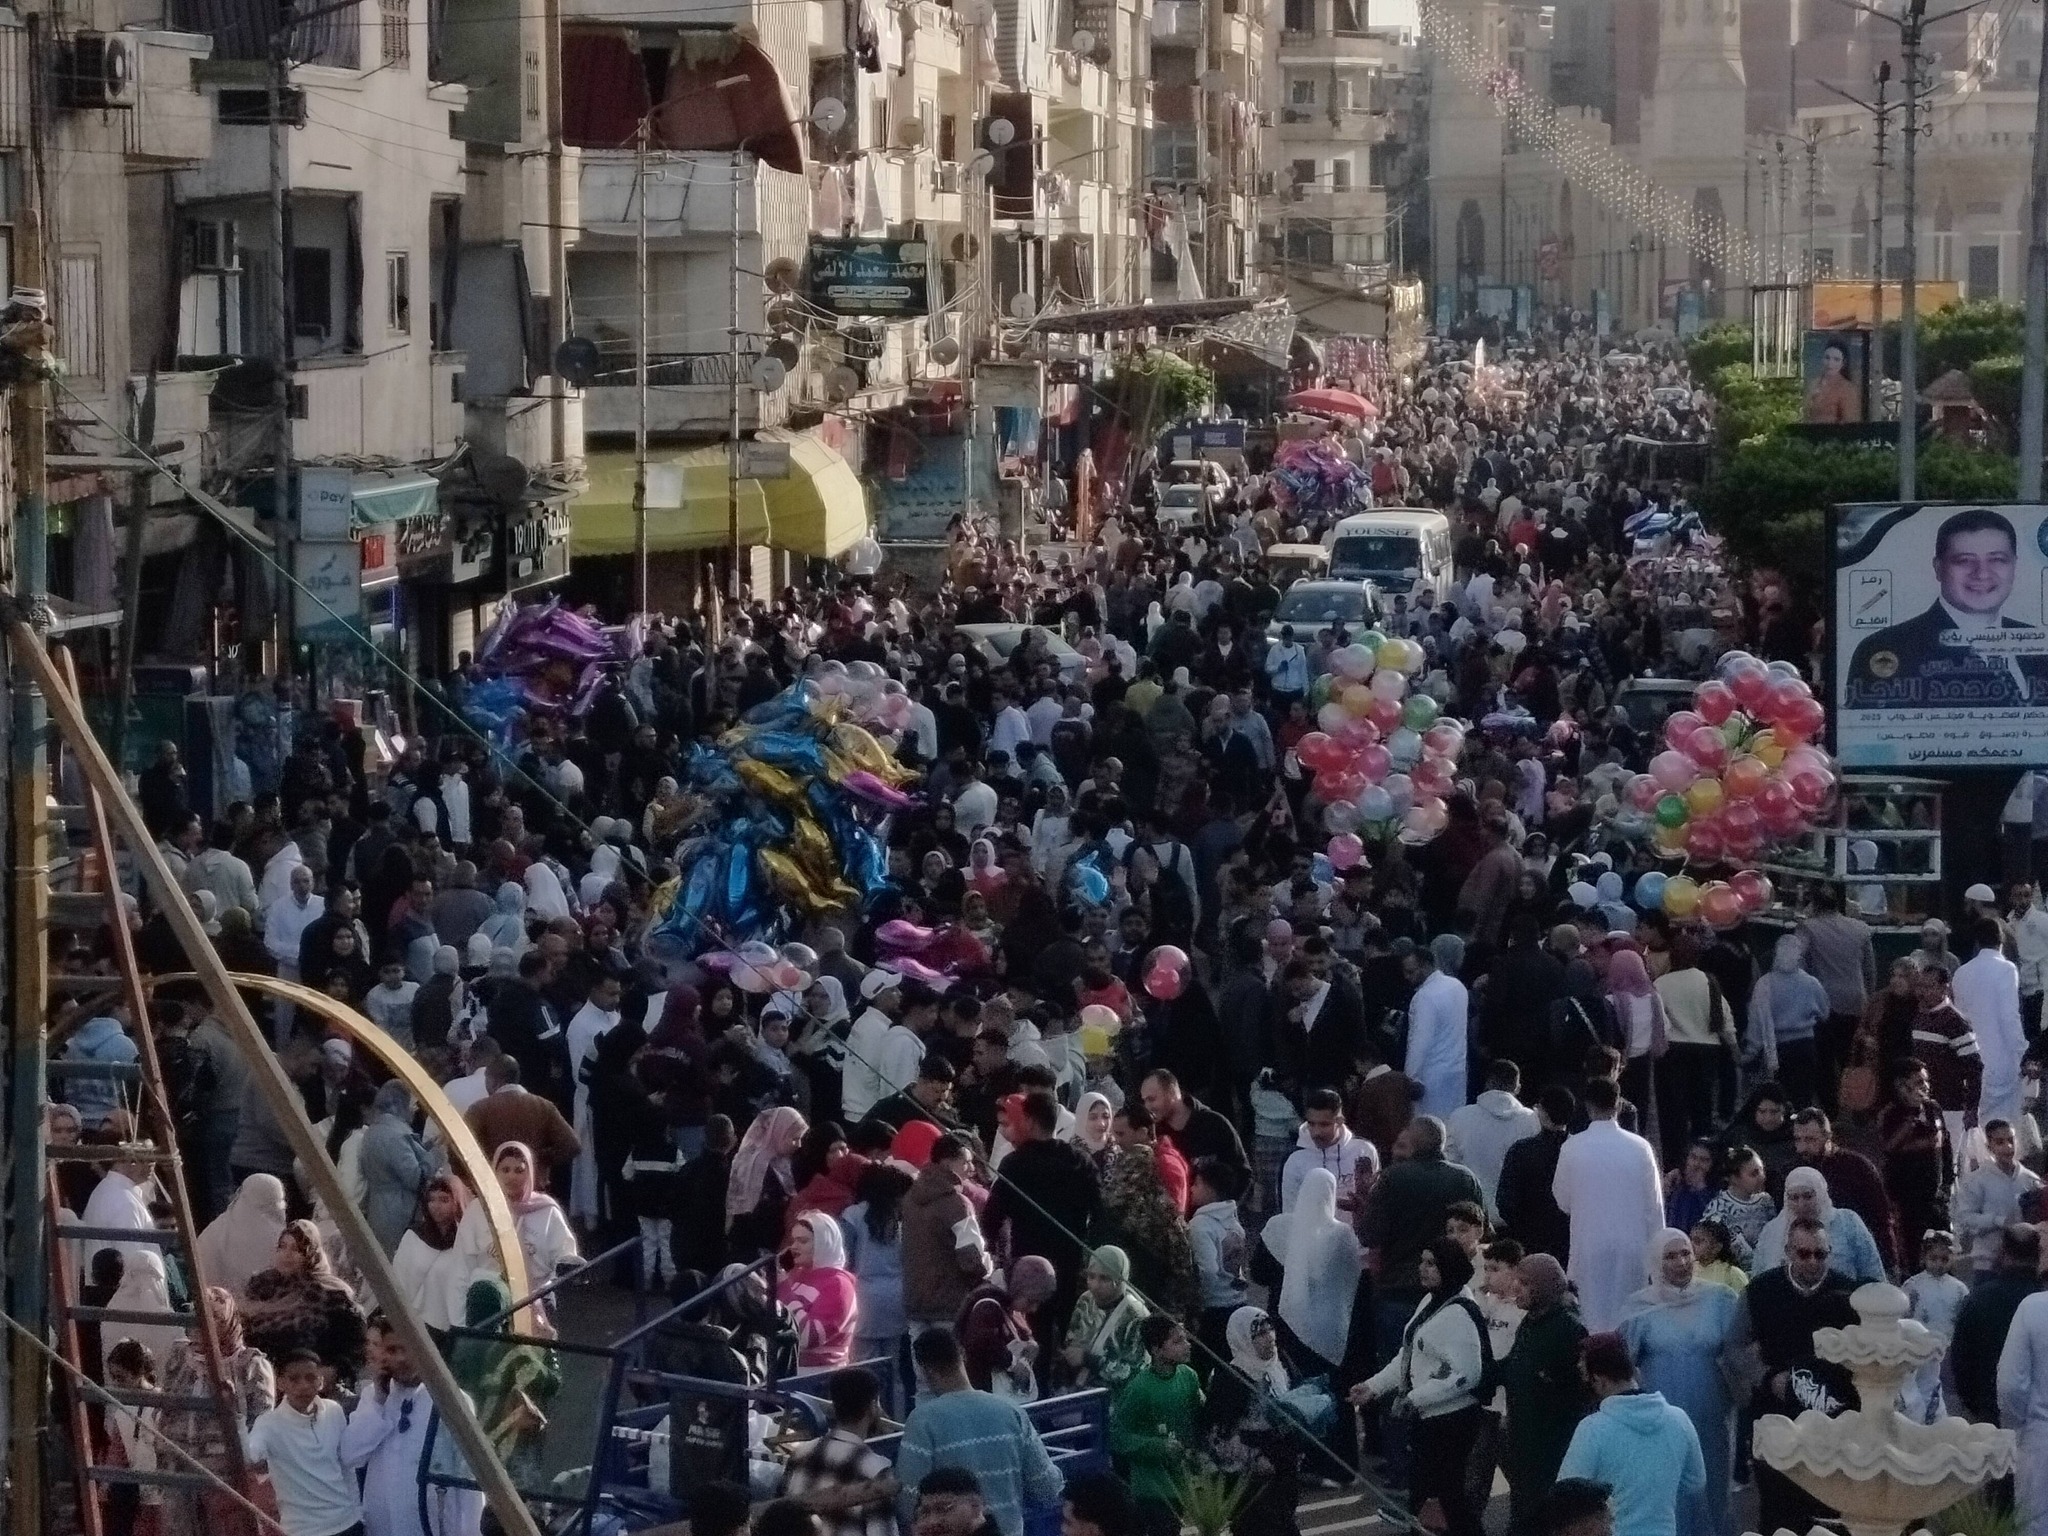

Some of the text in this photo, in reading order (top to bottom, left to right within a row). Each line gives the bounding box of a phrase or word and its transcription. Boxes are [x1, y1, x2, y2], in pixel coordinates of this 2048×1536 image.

[320, 491, 345, 503] Pay
[1861, 575, 1882, 585] رمز
[1855, 616, 1888, 626] القلم
[2011, 631, 2045, 641] محمود
